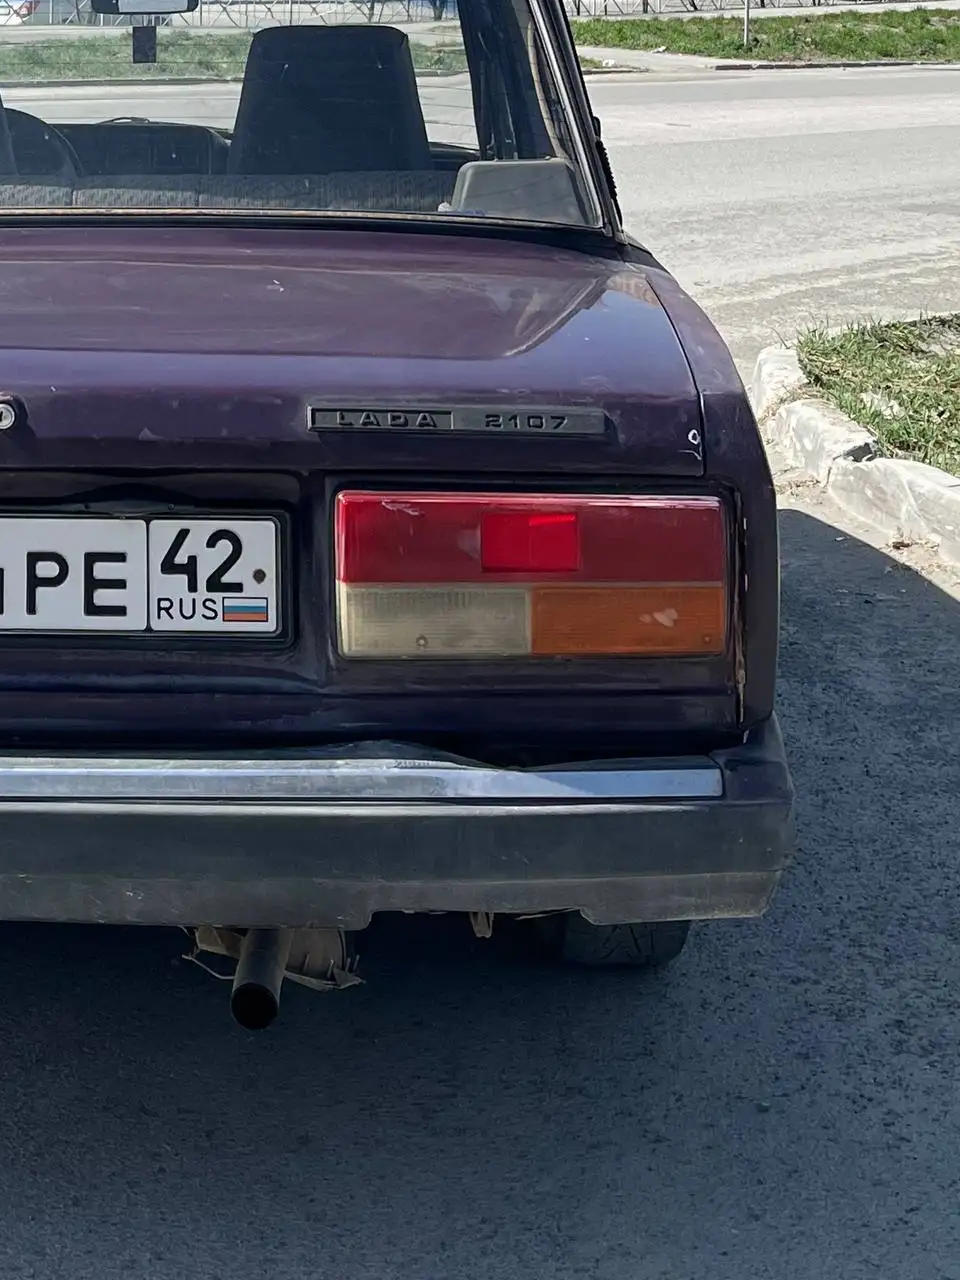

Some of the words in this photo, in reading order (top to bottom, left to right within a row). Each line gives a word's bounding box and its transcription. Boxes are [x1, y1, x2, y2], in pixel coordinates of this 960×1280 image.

[336, 411, 438, 429] LADA
[484, 414, 568, 430] 2107
[159, 528, 245, 593] 42
[155, 597, 219, 621] RUS
